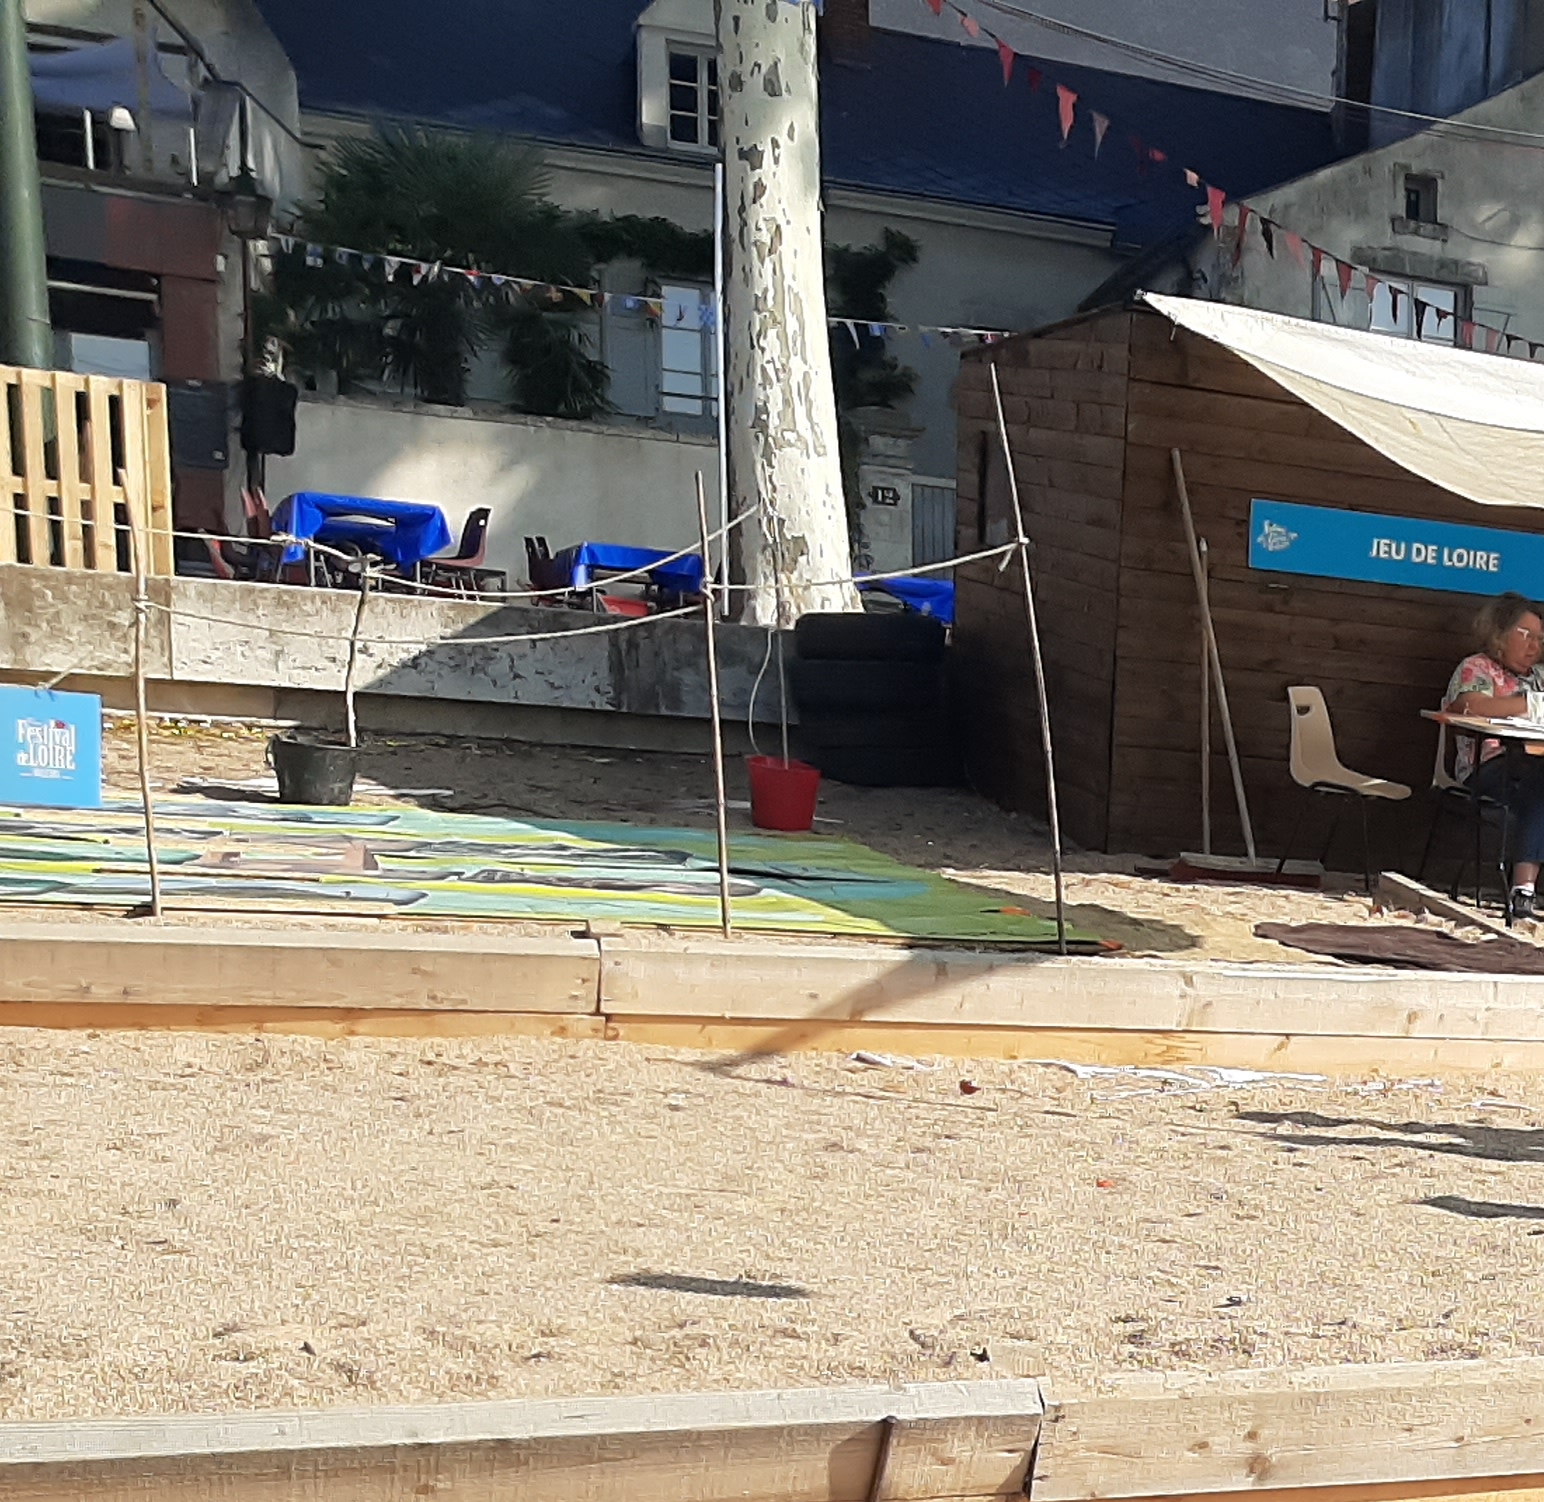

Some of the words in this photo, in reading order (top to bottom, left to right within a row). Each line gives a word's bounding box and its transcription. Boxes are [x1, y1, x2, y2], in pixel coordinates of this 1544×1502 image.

[1369, 537, 1406, 560] JEU
[1411, 543, 1438, 565] DE
[1443, 547, 1500, 572] LOIRE
[16, 718, 76, 754] Festival
[28, 742, 76, 770] LOIRE
